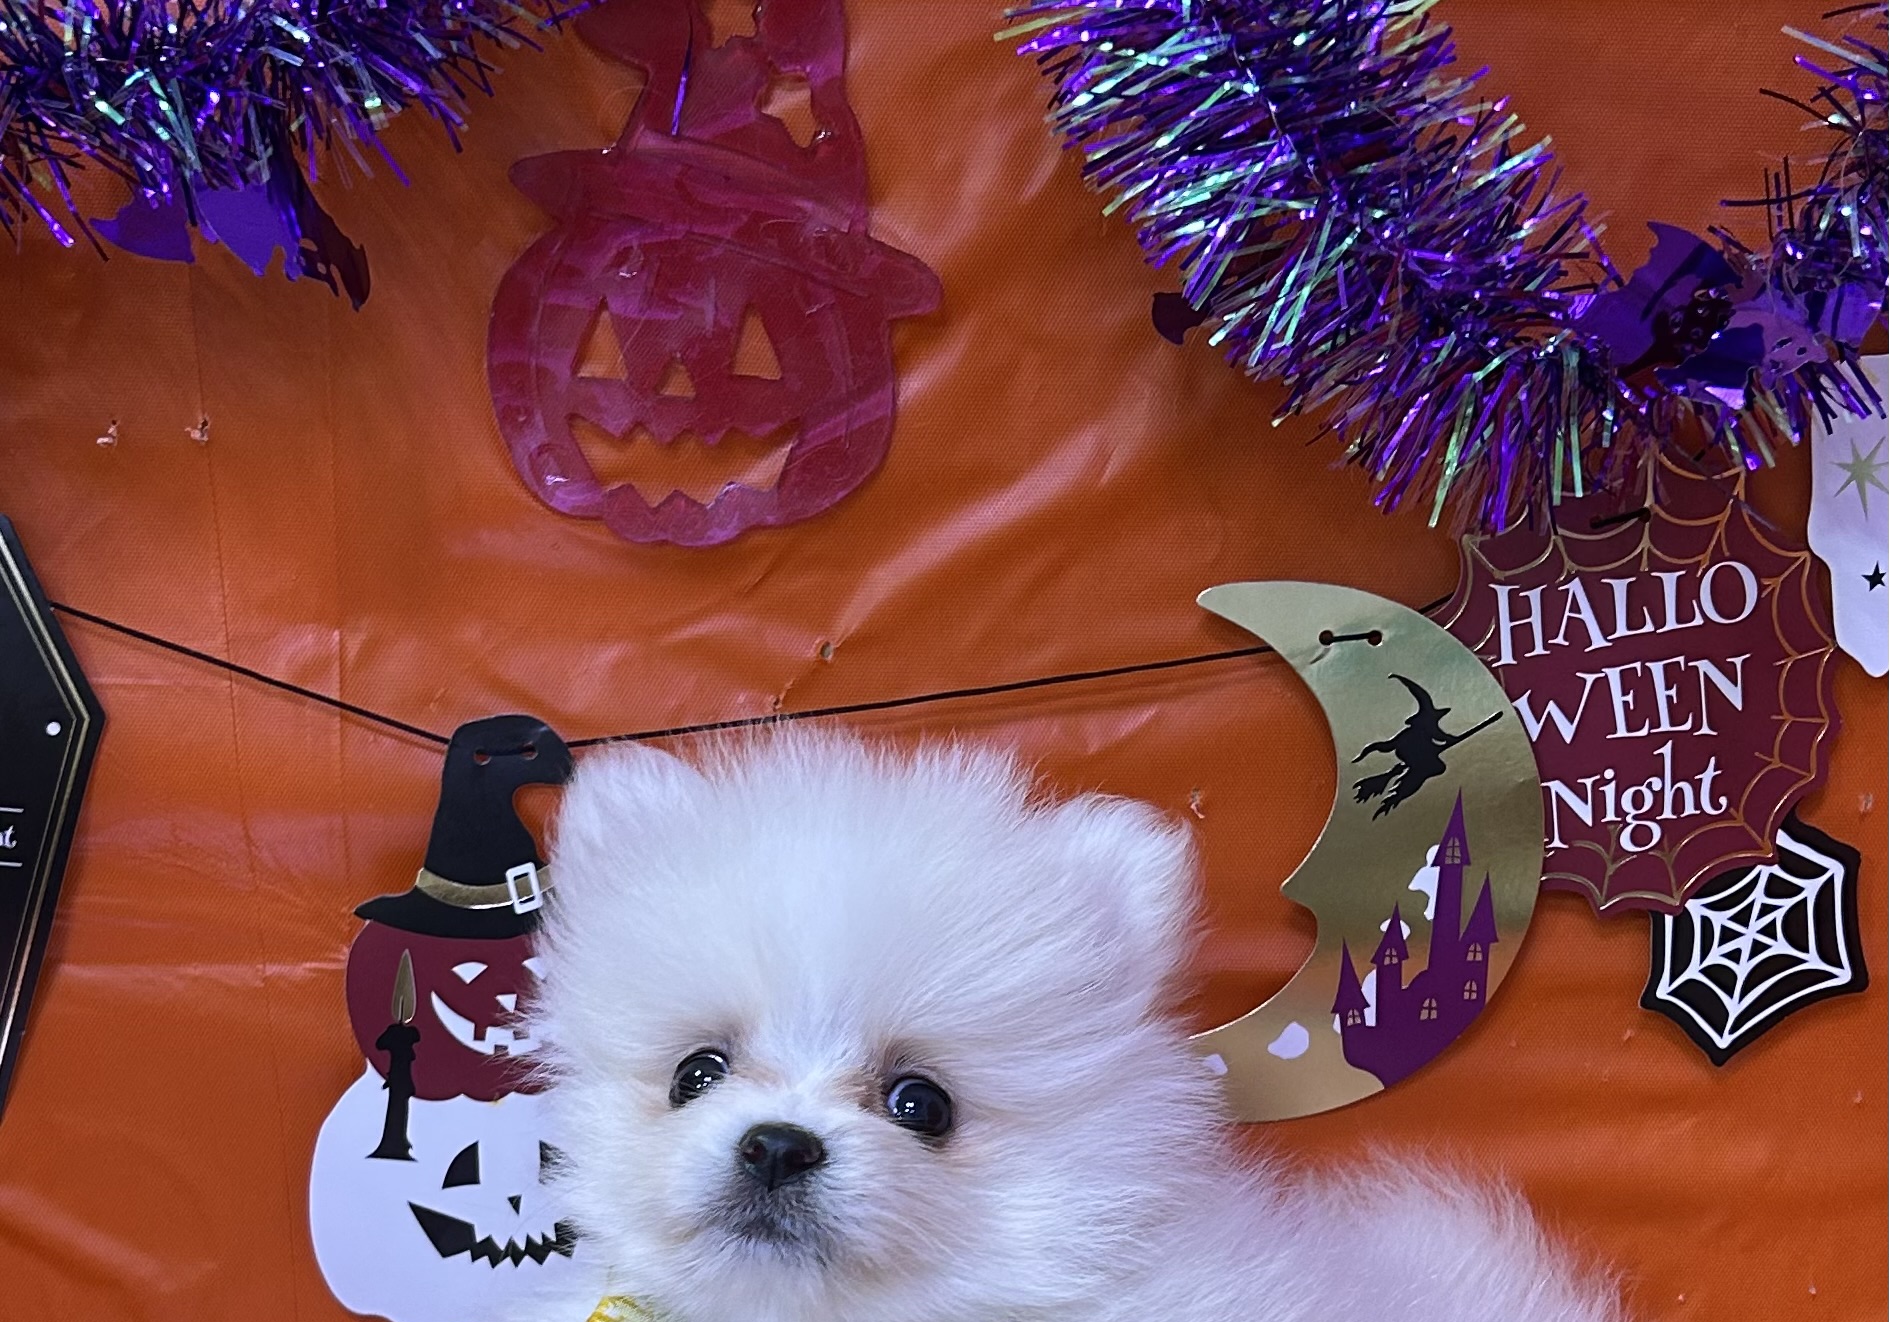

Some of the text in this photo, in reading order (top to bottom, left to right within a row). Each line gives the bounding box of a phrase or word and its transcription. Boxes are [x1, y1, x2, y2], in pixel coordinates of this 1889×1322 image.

[1489, 560, 1758, 667] HALLO
[1511, 653, 1752, 744] WEEN
[1540, 740, 1728, 852] Night
